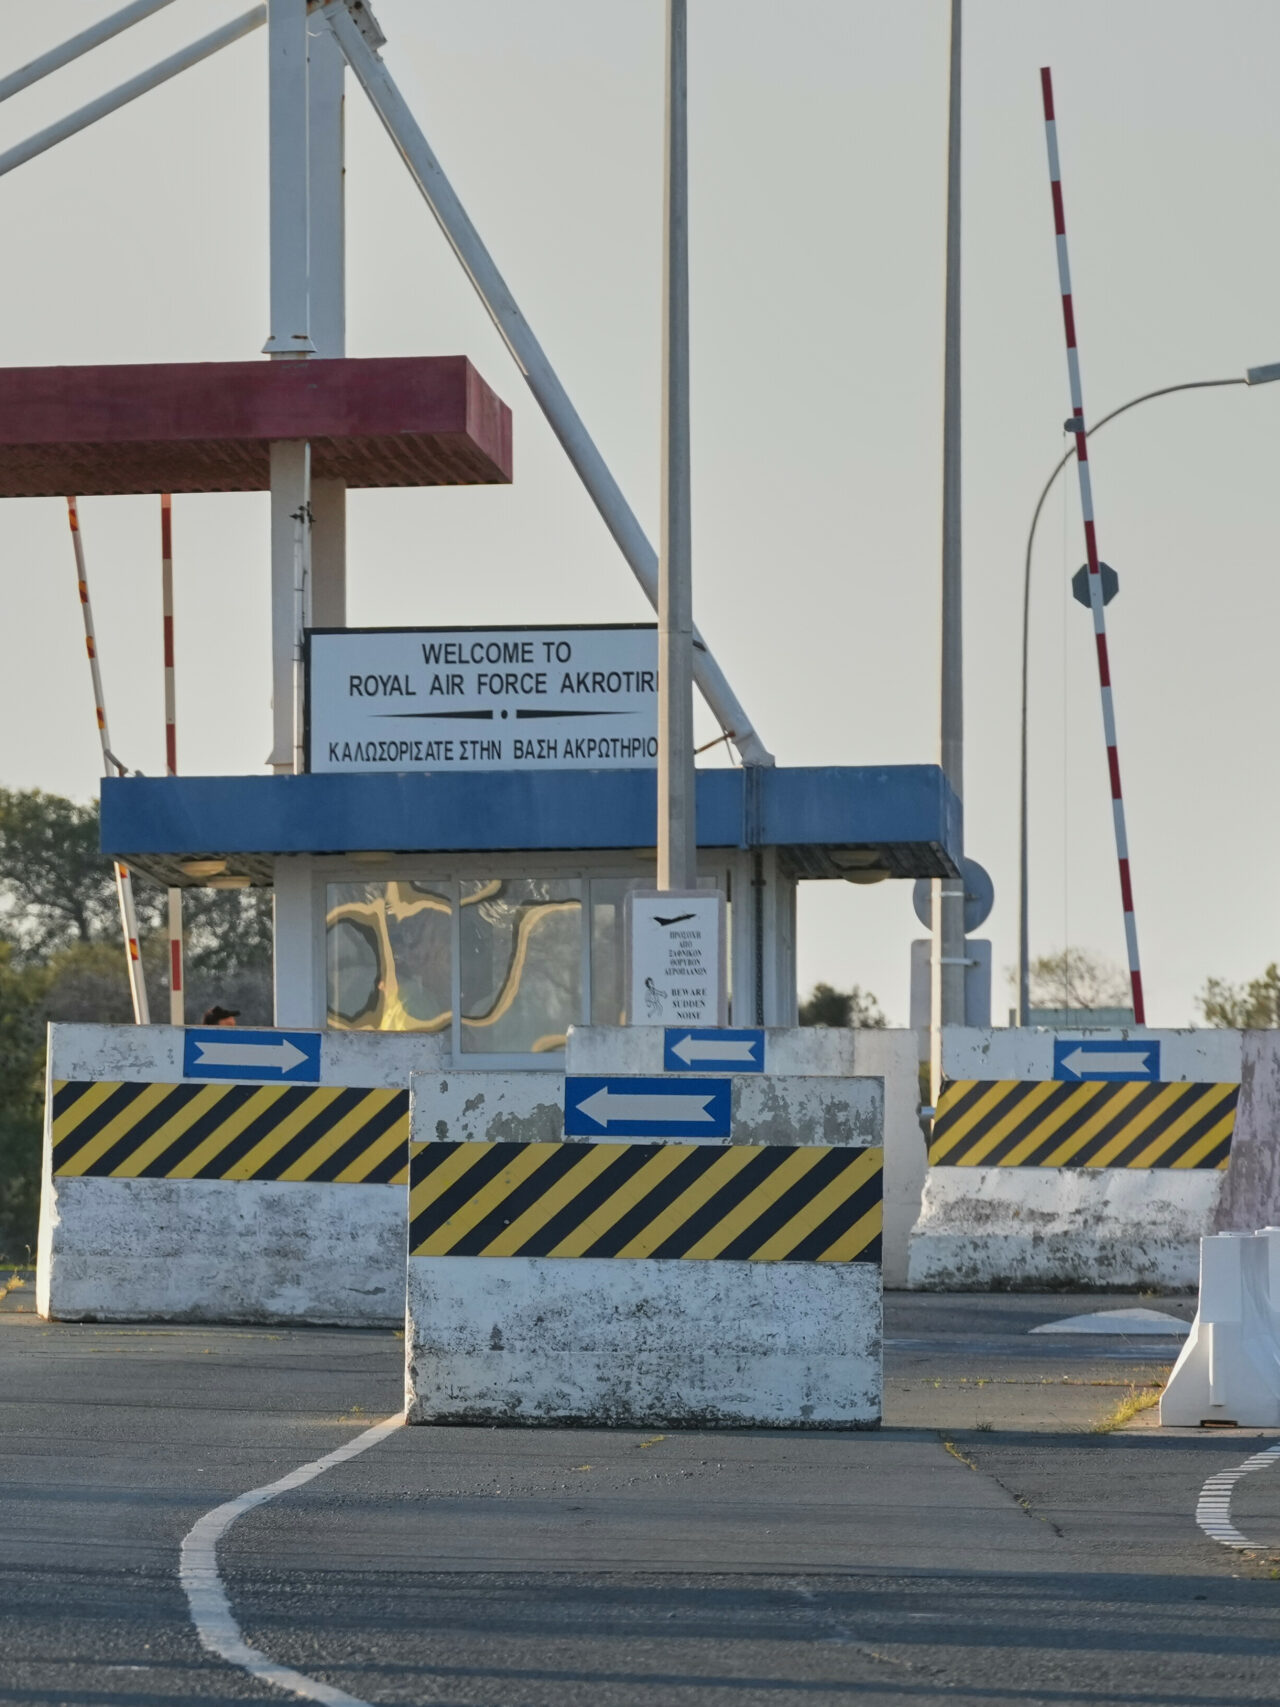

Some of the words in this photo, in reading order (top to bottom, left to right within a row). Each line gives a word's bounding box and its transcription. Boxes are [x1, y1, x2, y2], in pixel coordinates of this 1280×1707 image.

[422, 642, 534, 664] WELCOME
[542, 641, 571, 663] TO
[349, 675, 417, 696] ROYAL
[429, 674, 465, 695] AIR
[477, 673, 548, 695] FORCE
[329, 741, 454, 762] ΚΑΛΩΣΟΡΙΣΑΤΕ
[459, 740, 502, 761] ΣΤΗΝ
[514, 739, 558, 760] ΒΑΣΗ
[671, 988, 706, 997] BEWARE
[672, 1000, 706, 1009] SUDDEN
